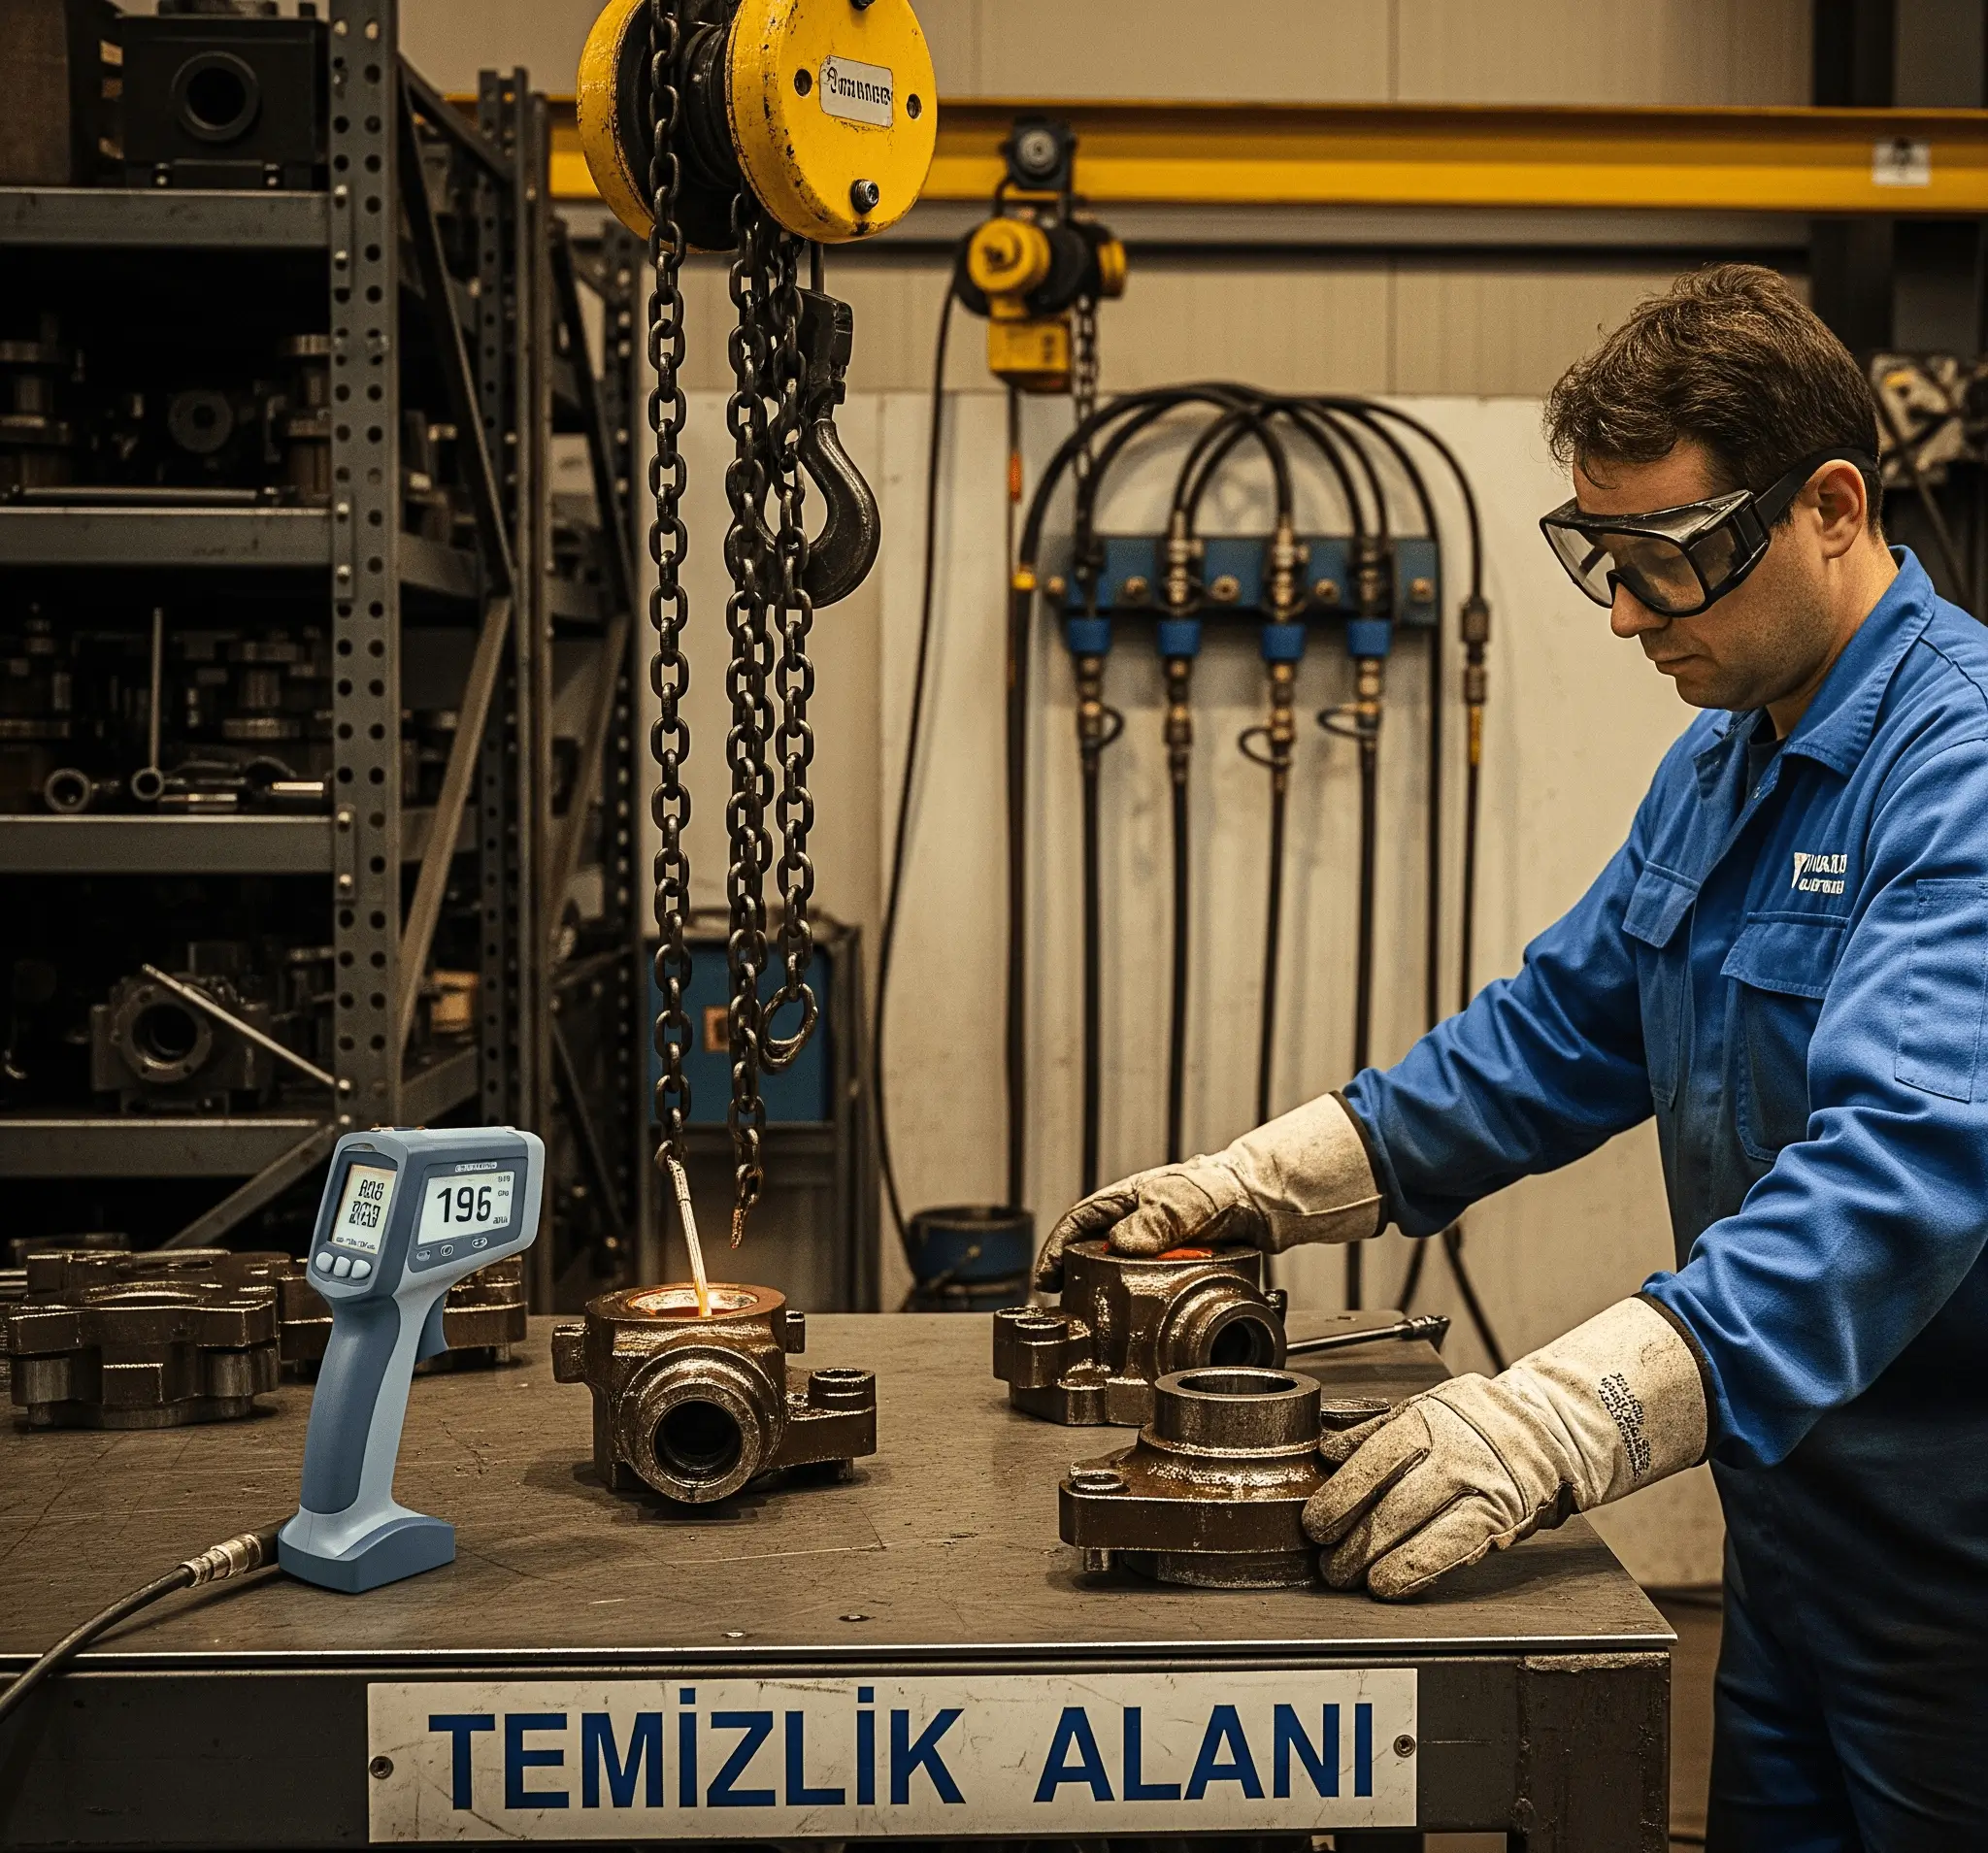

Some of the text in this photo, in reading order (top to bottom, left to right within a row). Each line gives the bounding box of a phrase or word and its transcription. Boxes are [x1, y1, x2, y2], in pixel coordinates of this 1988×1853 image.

[437, 1185, 492, 1223] 196
[428, 1686, 1374, 1810] TEMİZLİK ALANI
